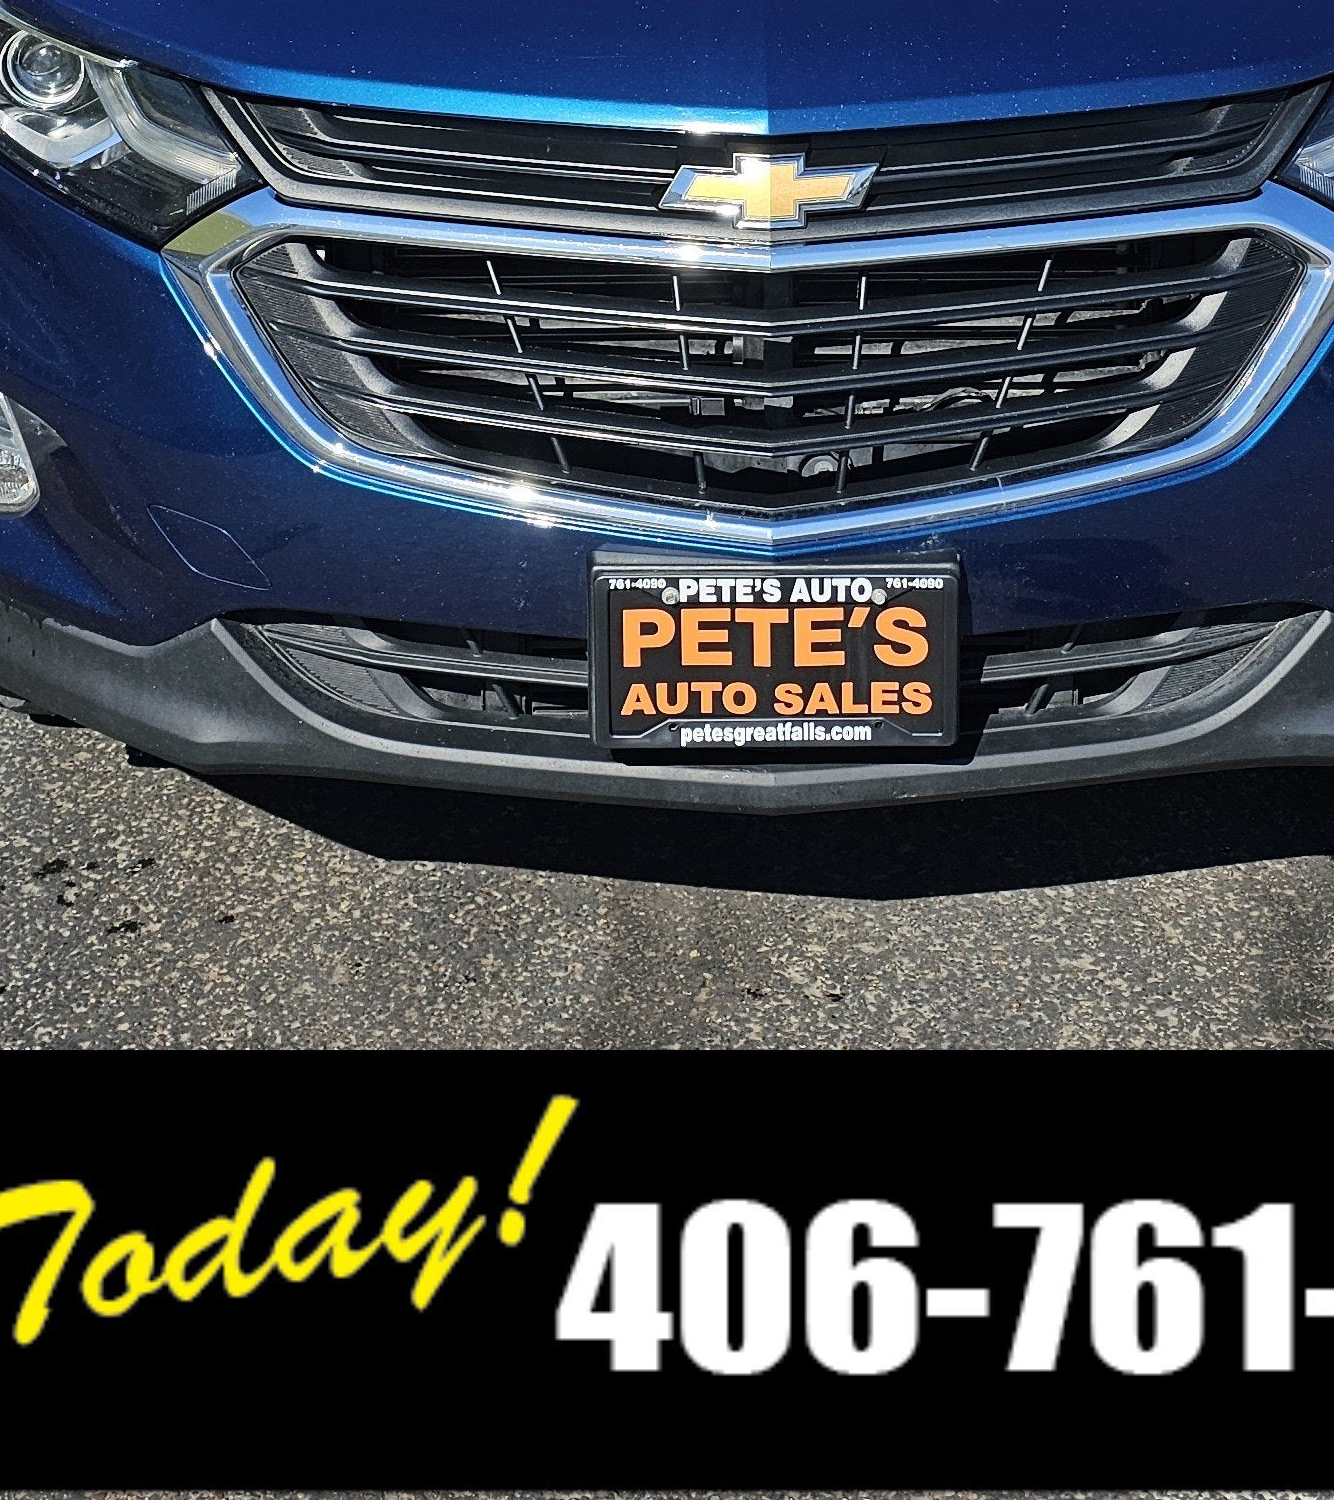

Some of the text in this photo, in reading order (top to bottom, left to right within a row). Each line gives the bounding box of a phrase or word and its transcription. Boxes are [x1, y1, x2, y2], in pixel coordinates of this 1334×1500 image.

[679, 578, 873, 604] PETE'S AUTO
[622, 606, 930, 668] PETE'S
[620, 681, 933, 716] AUTO SALES
[679, 722, 873, 747] petesgreatfalls.com
